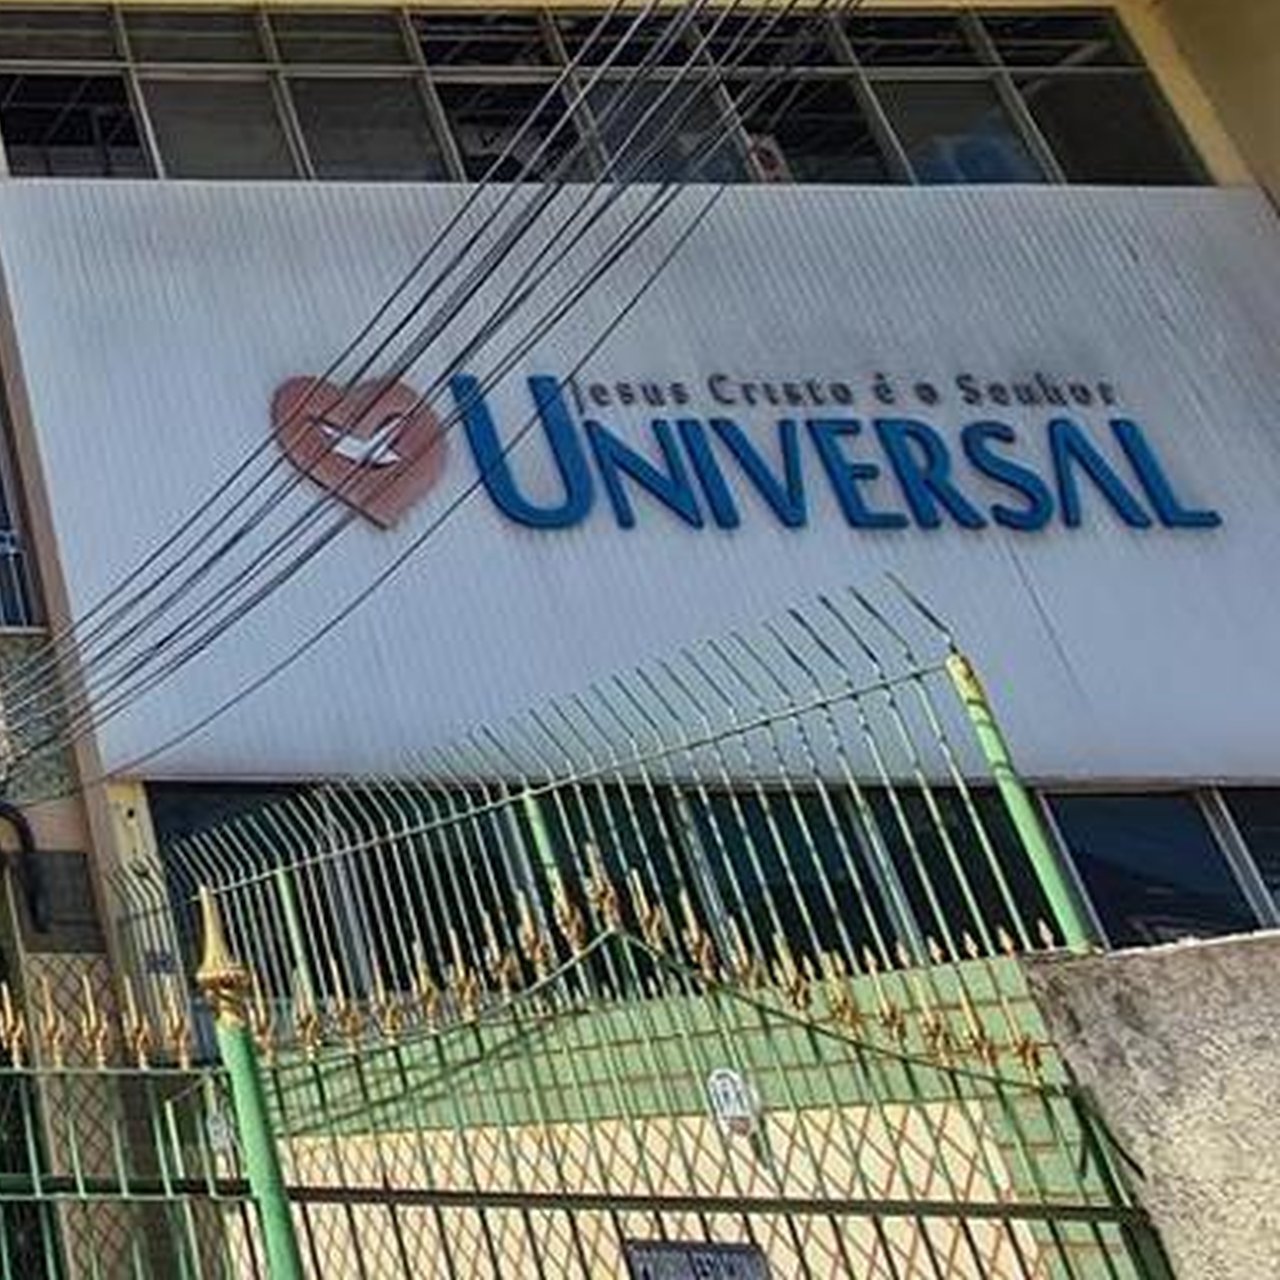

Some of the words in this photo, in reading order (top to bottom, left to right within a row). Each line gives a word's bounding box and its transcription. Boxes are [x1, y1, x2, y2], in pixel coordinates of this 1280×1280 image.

[568, 377, 691, 416] Jesus
[706, 372, 853, 407] Cristo
[871, 372, 896, 406] é
[912, 378, 940, 406] o
[954, 370, 1117, 407] Senhor
[448, 372, 1224, 532] UNIVERSAL
